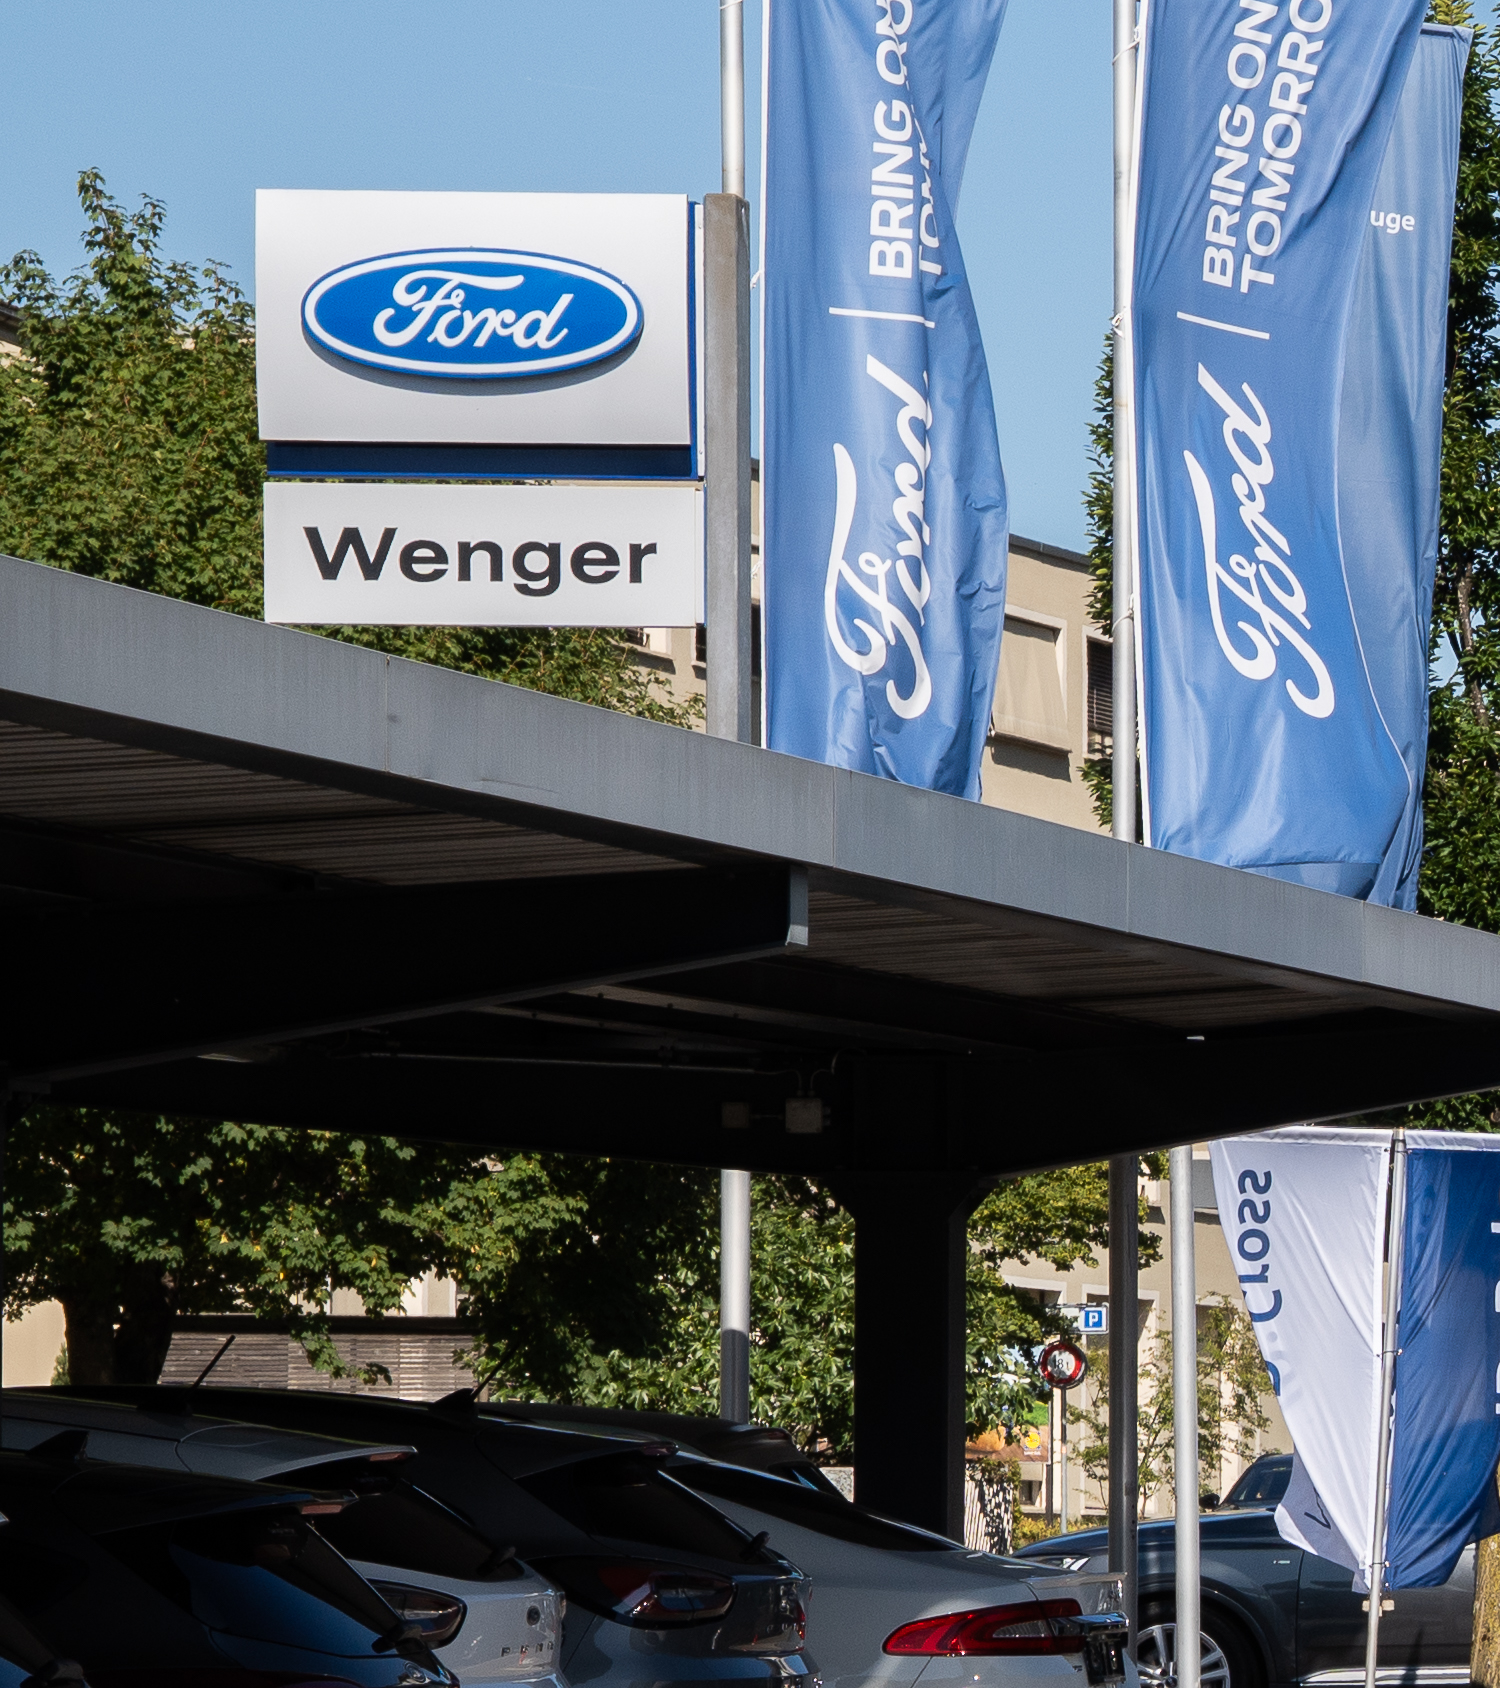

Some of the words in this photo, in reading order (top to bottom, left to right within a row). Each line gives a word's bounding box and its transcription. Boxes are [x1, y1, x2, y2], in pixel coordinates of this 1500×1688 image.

[1226, 0, 1279, 90] ON
[868, 100, 914, 279] BRING
[1202, 103, 1256, 288] BRING
[372, 270, 568, 350] Ford
[304, 526, 657, 597] Wenger
[824, 353, 932, 720] Ford
[1181, 361, 1336, 720] Ford
